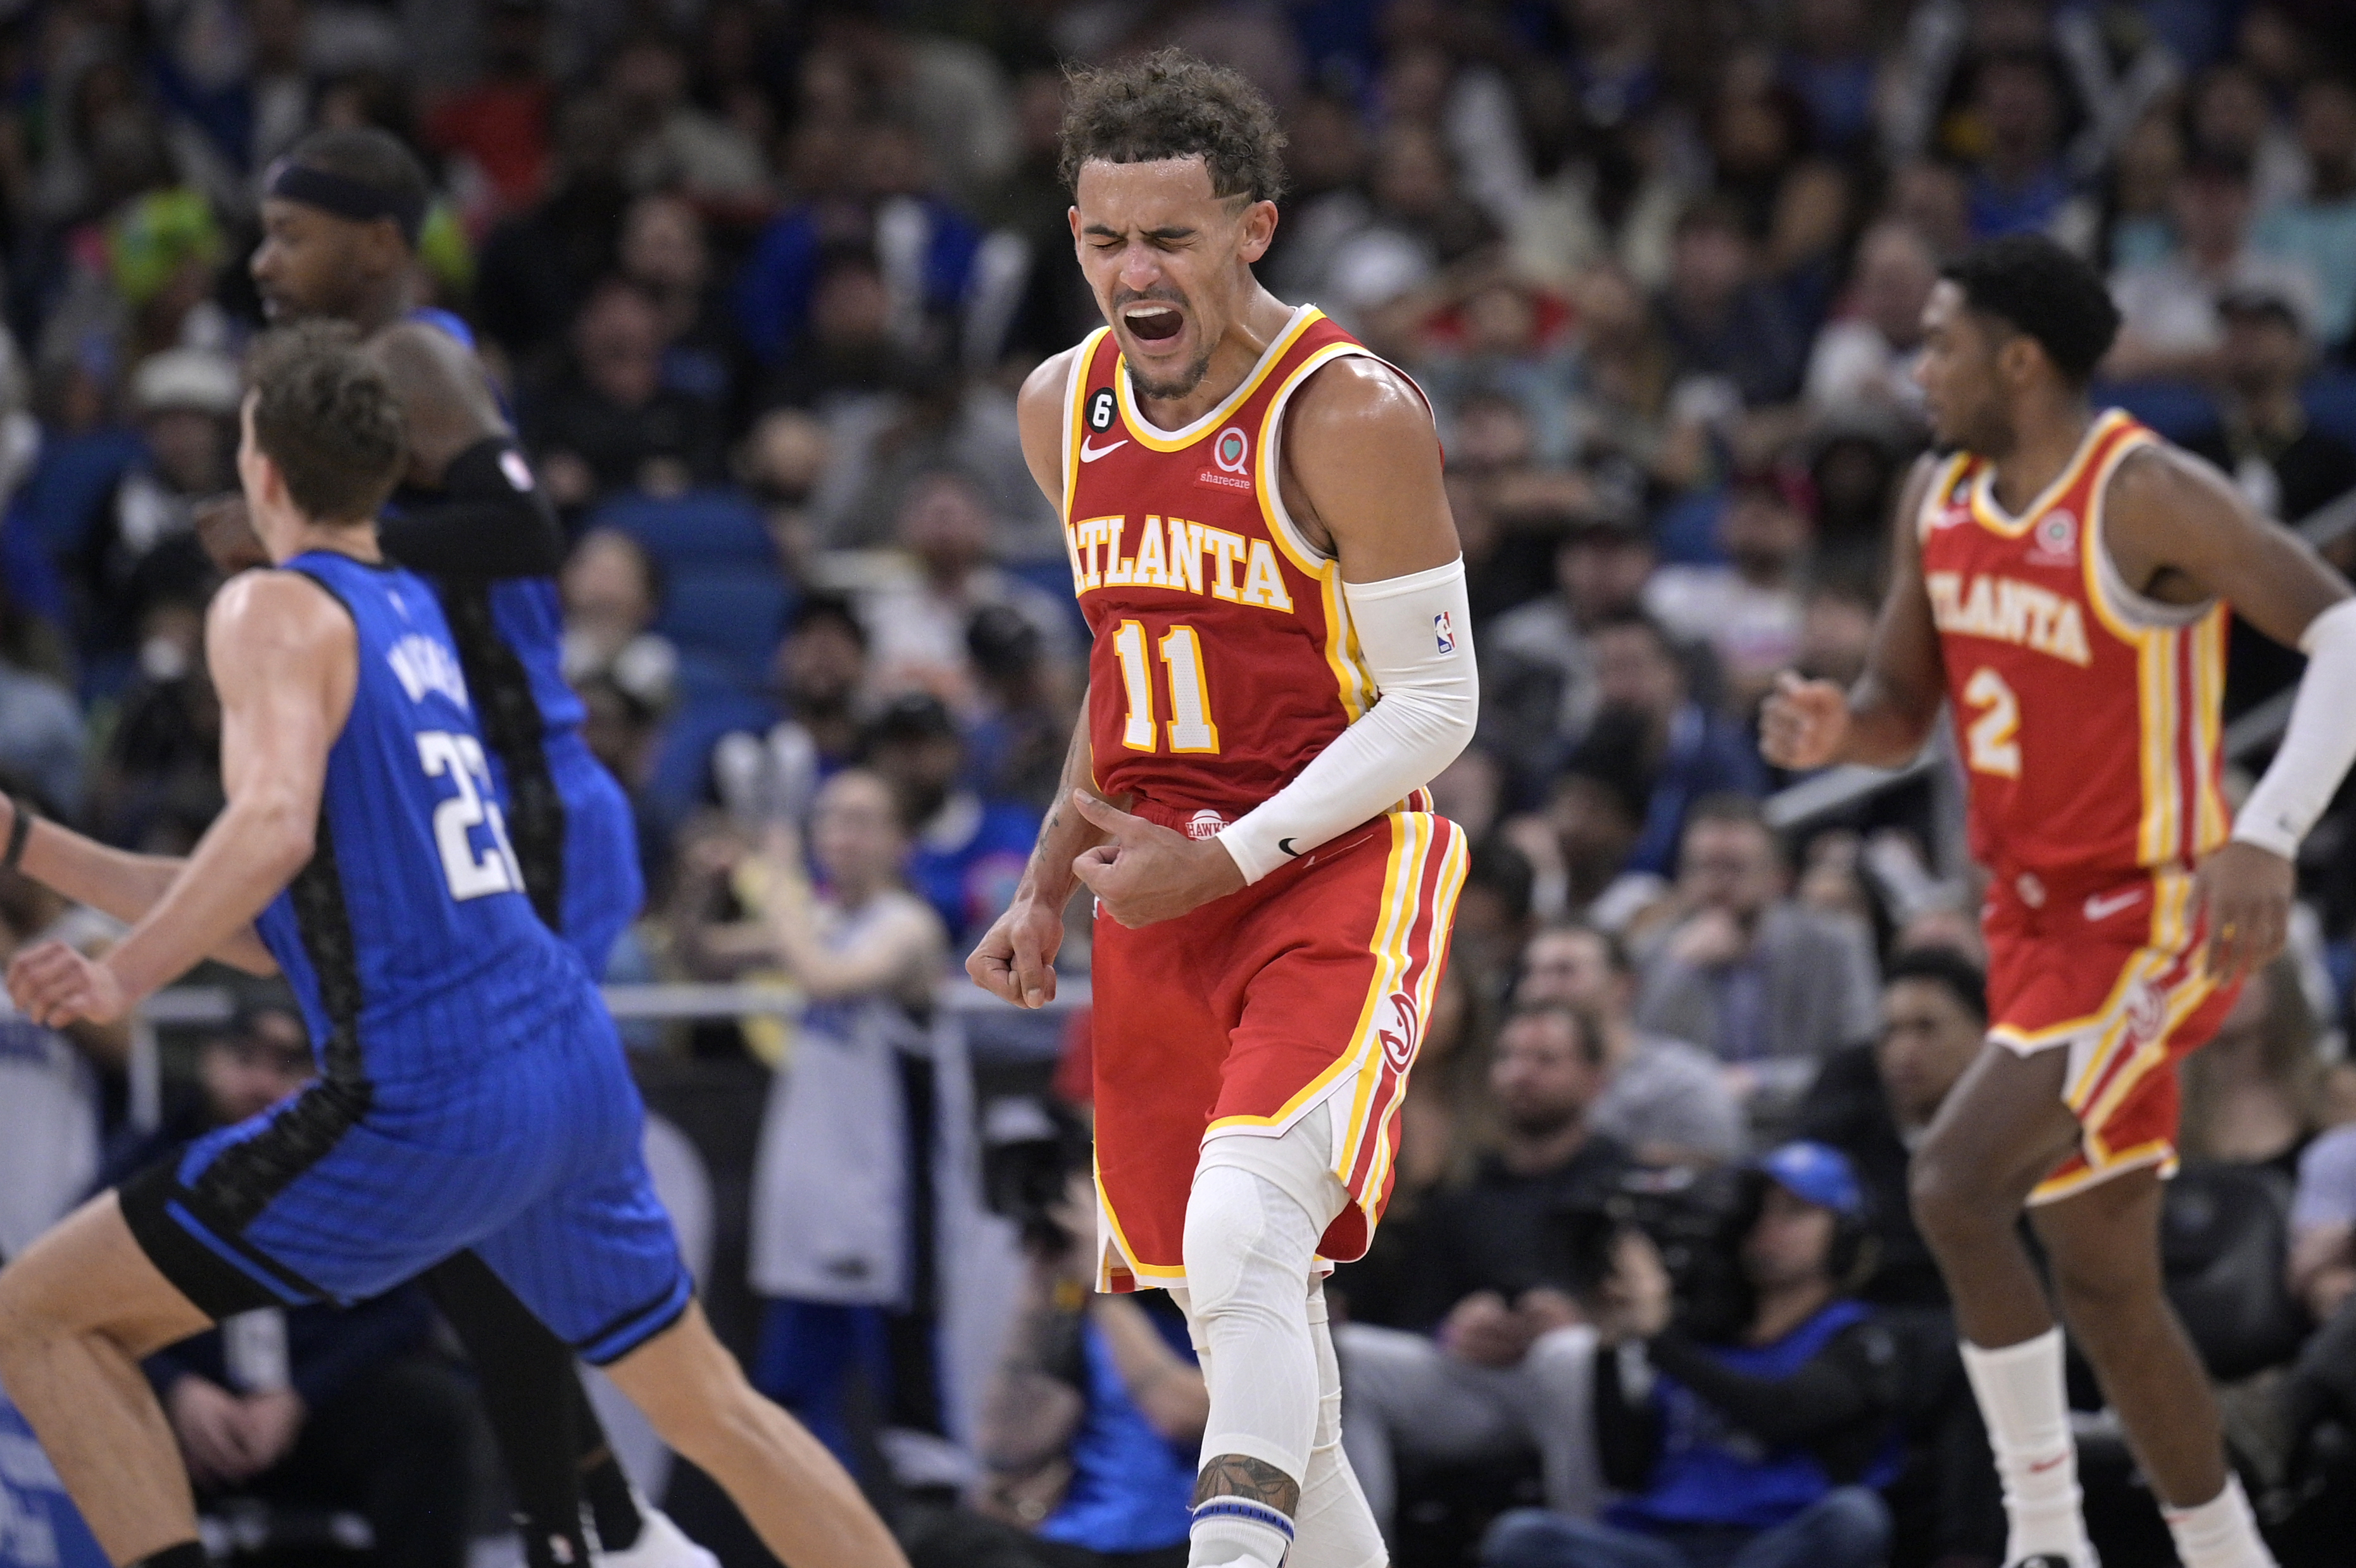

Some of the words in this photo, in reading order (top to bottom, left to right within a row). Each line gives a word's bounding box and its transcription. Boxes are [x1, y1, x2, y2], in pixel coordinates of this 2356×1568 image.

[1092, 394, 1113, 428] 6
[1200, 471, 1251, 489] sharecare
[1926, 572, 2092, 668] TLANTA
[1112, 619, 1220, 755] 11
[1966, 667, 2022, 779] 2
